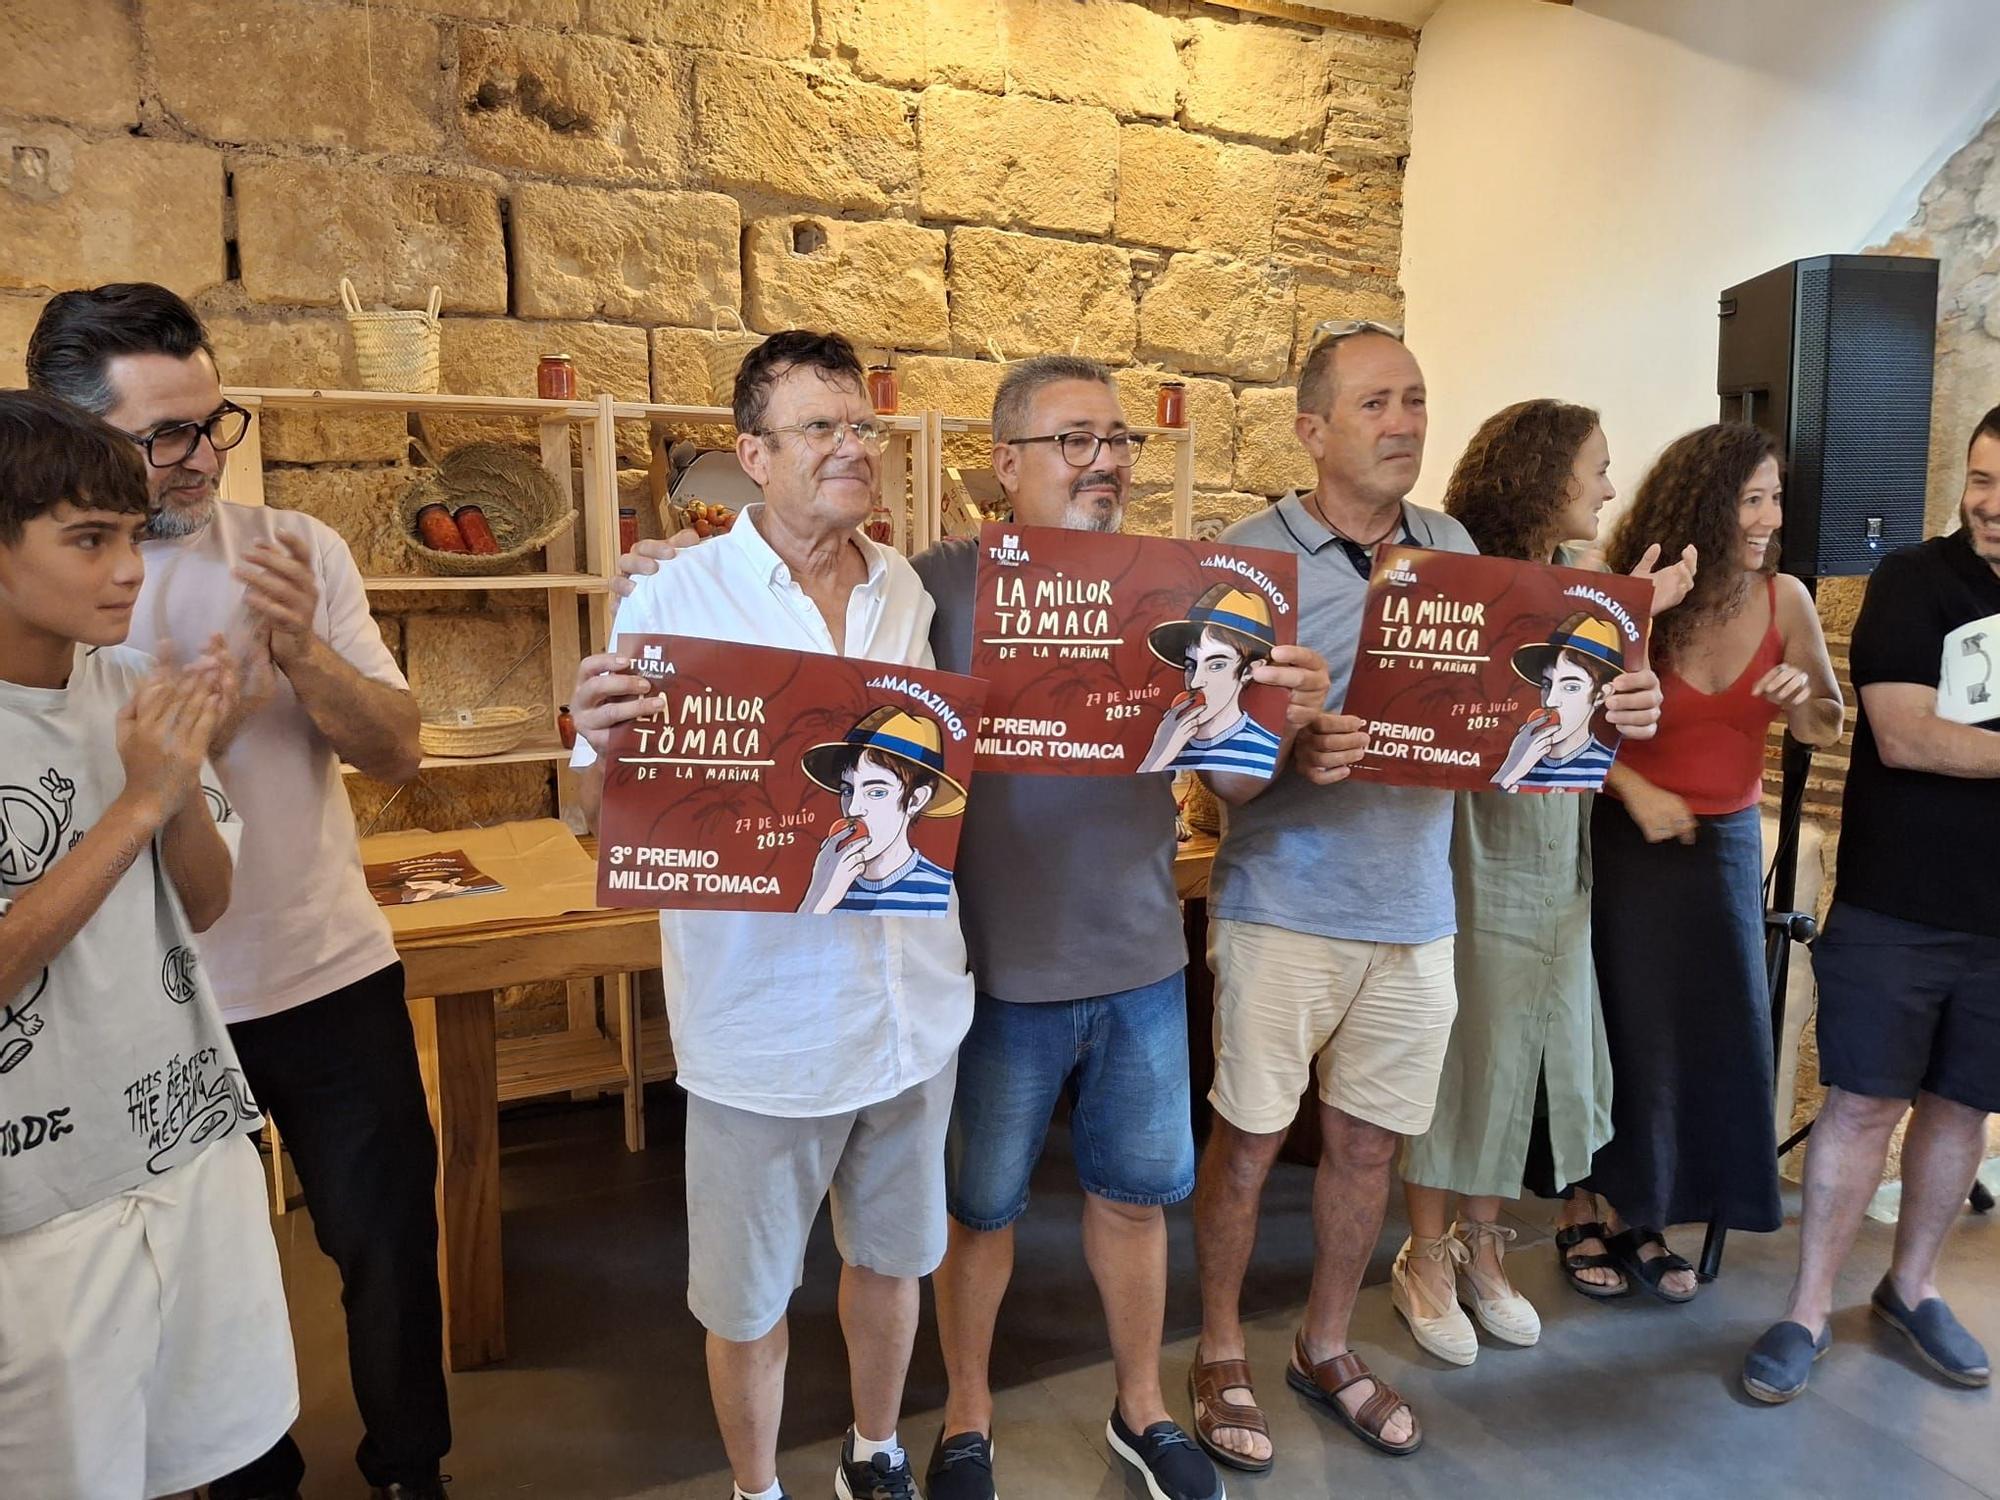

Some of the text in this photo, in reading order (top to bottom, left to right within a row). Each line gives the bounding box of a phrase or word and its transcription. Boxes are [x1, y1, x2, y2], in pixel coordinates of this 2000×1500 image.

[989, 547, 1030, 562] TURIA
[1383, 569, 1418, 583] TURIA
[996, 577, 1026, 608] LA
[1382, 595, 1409, 624] LA
[1000, 646, 1017, 660] DE
[1032, 646, 1049, 658] LA
[629, 658, 676, 674] TURIA
[1379, 657, 1396, 669] DE
[1408, 659, 1424, 670] LA
[1086, 693, 1101, 707] 27
[1107, 691, 1121, 704] DE
[1105, 704, 1141, 721] 2025
[1451, 703, 1465, 716] 27
[1470, 703, 1482, 715] DE
[993, 718, 1067, 737] PREMIO
[1368, 720, 1435, 743] PREMIO
[1467, 716, 1499, 731] 2025
[974, 738, 1125, 760] MILLOR TOMACA
[1412, 745, 1481, 767] TOMACA
[637, 766, 657, 780] DE
[676, 766, 693, 779] LA
[735, 818, 751, 834] 27
[758, 816, 772, 831] DE
[757, 831, 795, 850] 2025
[636, 847, 719, 868] PREMIO
[608, 870, 781, 895] MILLOR TOMACA
[124, 1053, 181, 1106] THIS IS
[128, 1094, 160, 1137] THE
